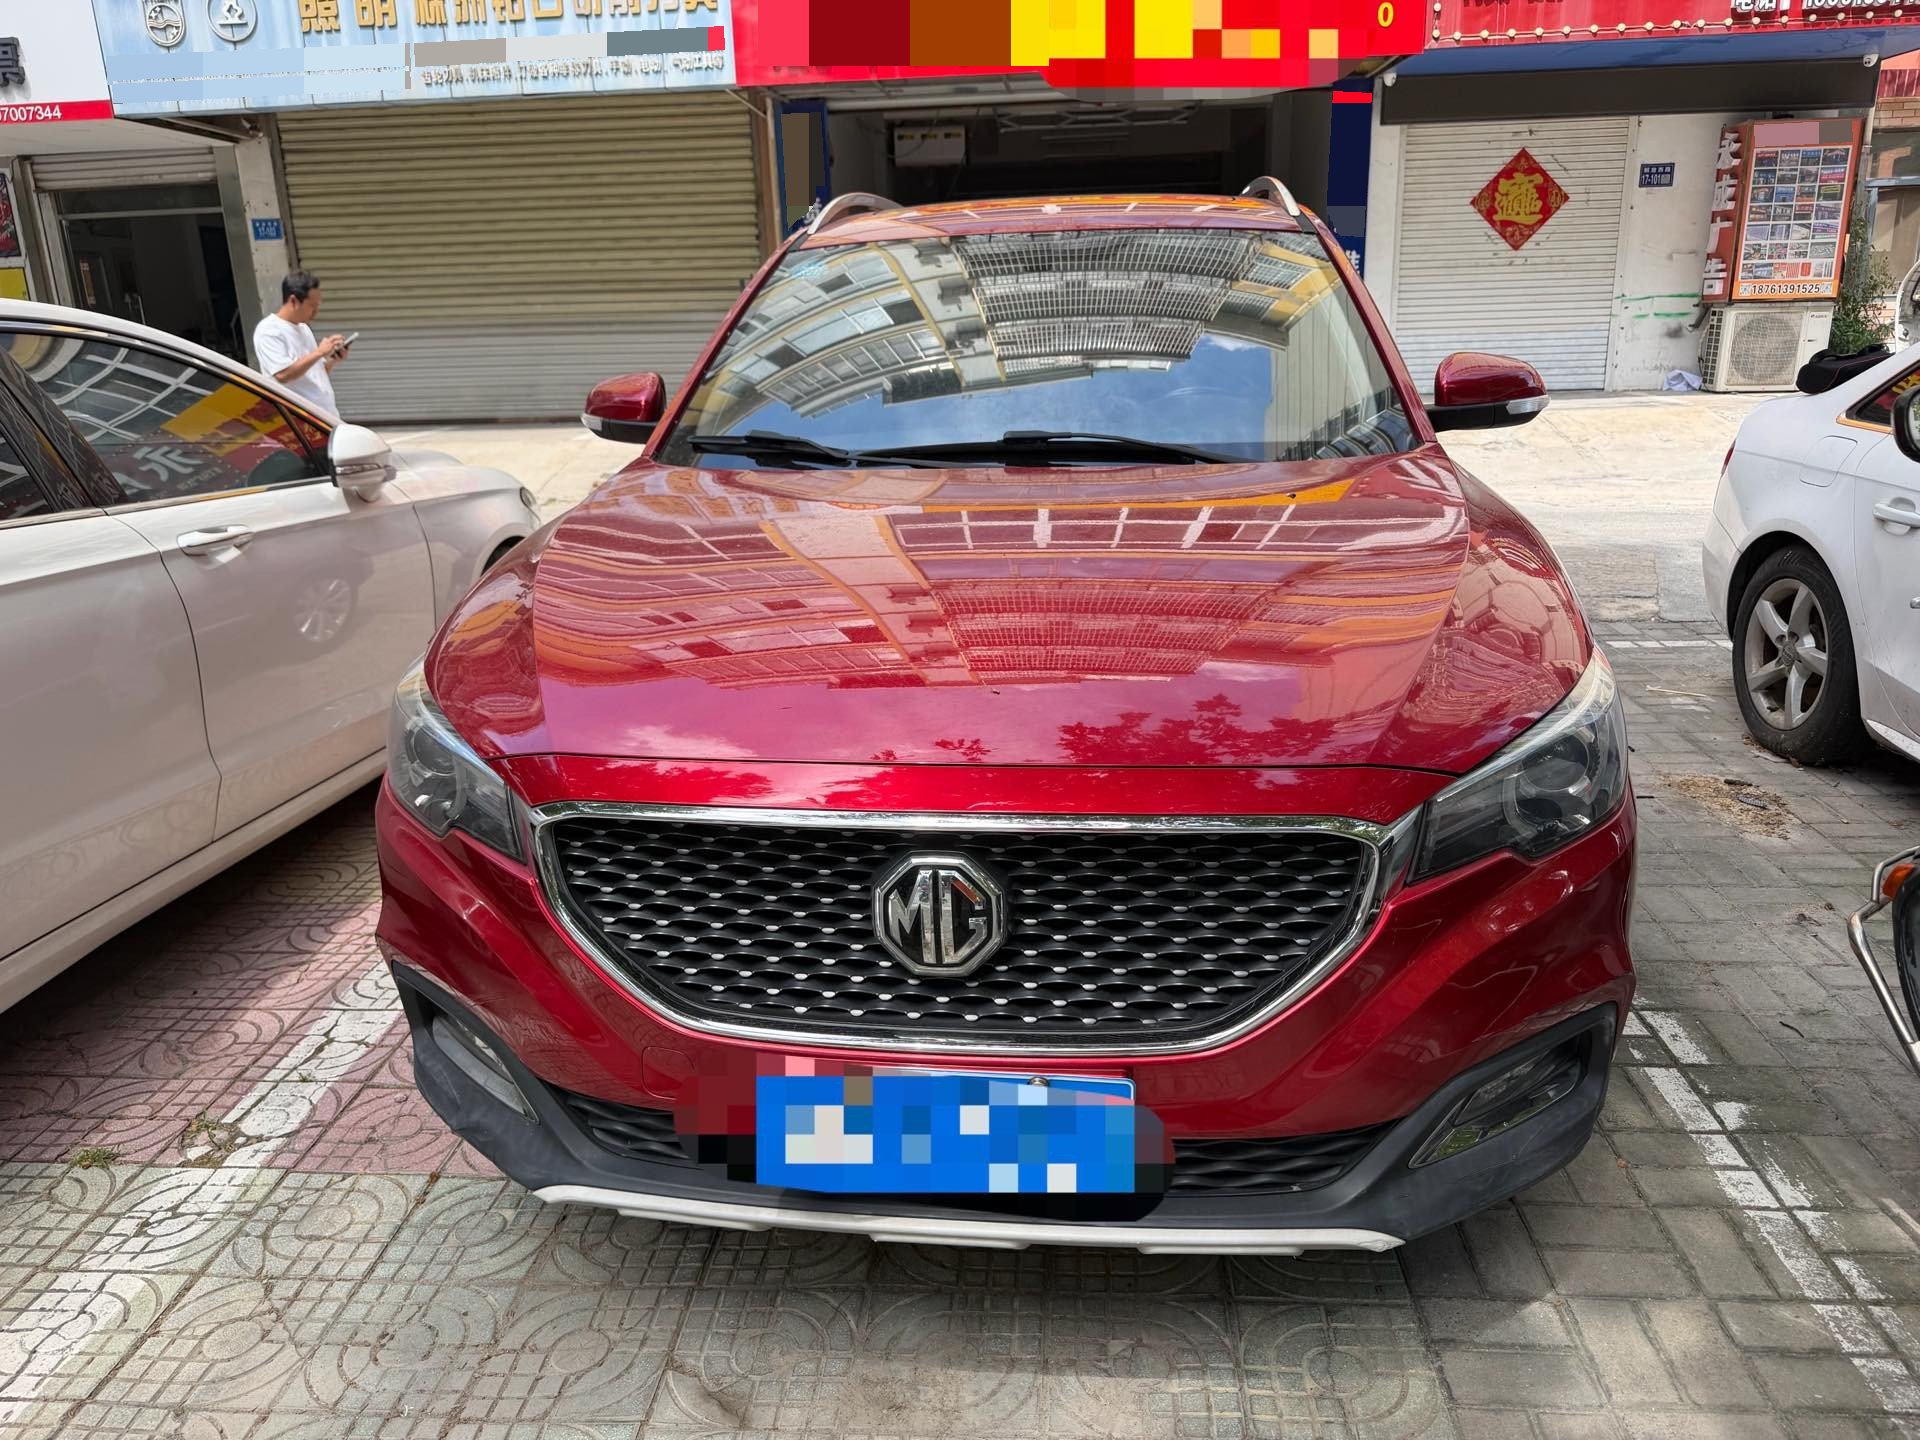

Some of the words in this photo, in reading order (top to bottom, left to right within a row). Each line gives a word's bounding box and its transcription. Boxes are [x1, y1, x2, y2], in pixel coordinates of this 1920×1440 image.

[0, 105, 62, 121] 7007344
[1752, 283, 1820, 294] 18761391525
[888, 869, 988, 964] MG
